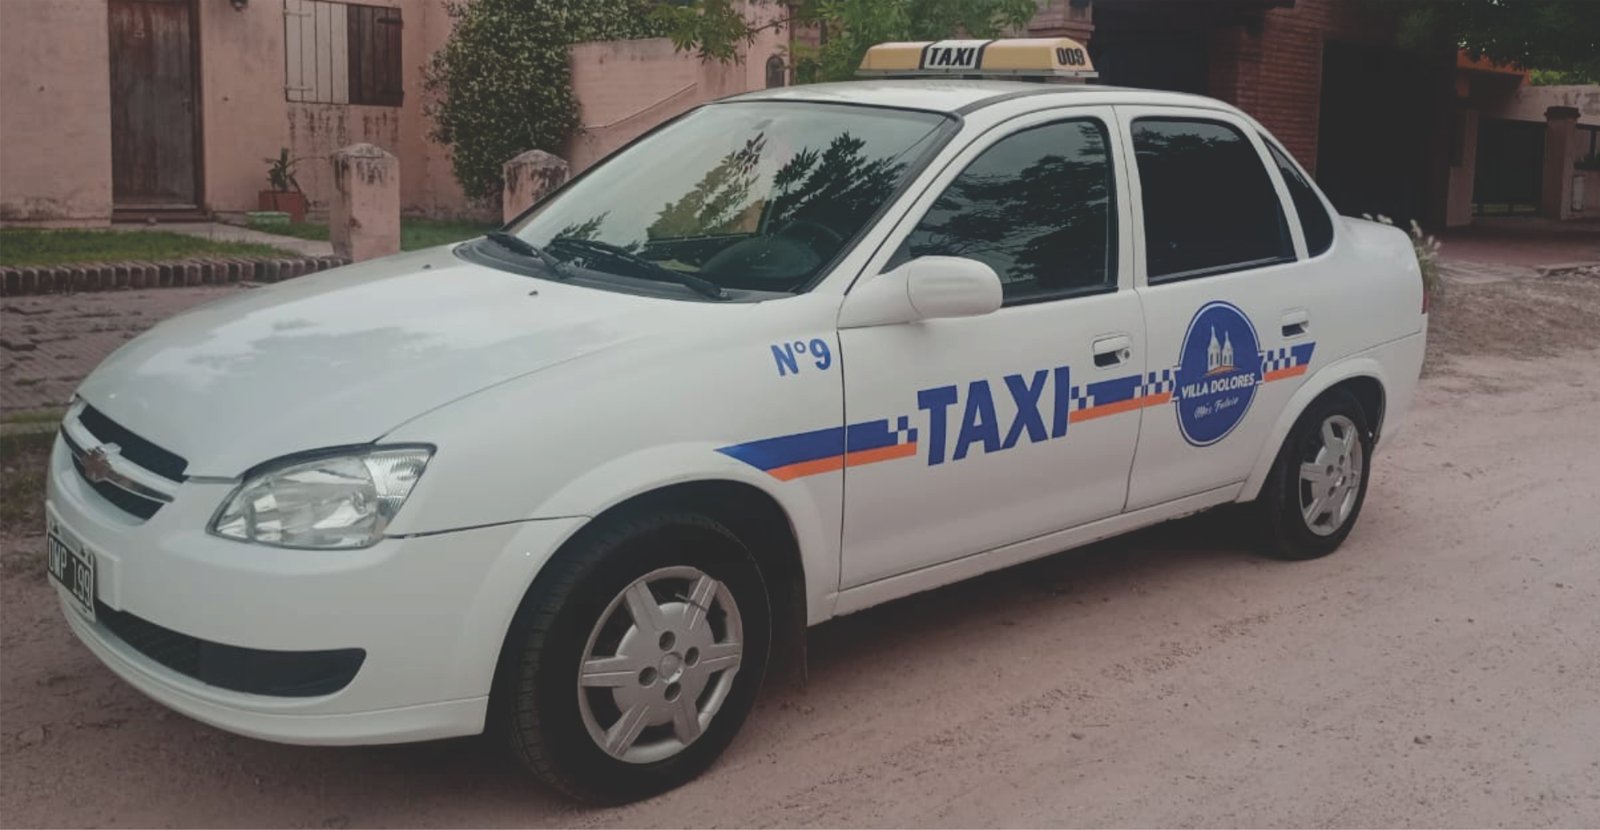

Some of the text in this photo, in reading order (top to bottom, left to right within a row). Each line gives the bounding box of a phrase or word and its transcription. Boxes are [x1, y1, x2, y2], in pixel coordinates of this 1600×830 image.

[929, 47, 976, 66] TAXI
[1056, 47, 1086, 66] 009
[1181, 373, 1255, 399] VILLA DOLORES
[917, 366, 1070, 466] TAXI
[73, 557, 90, 607] 199
